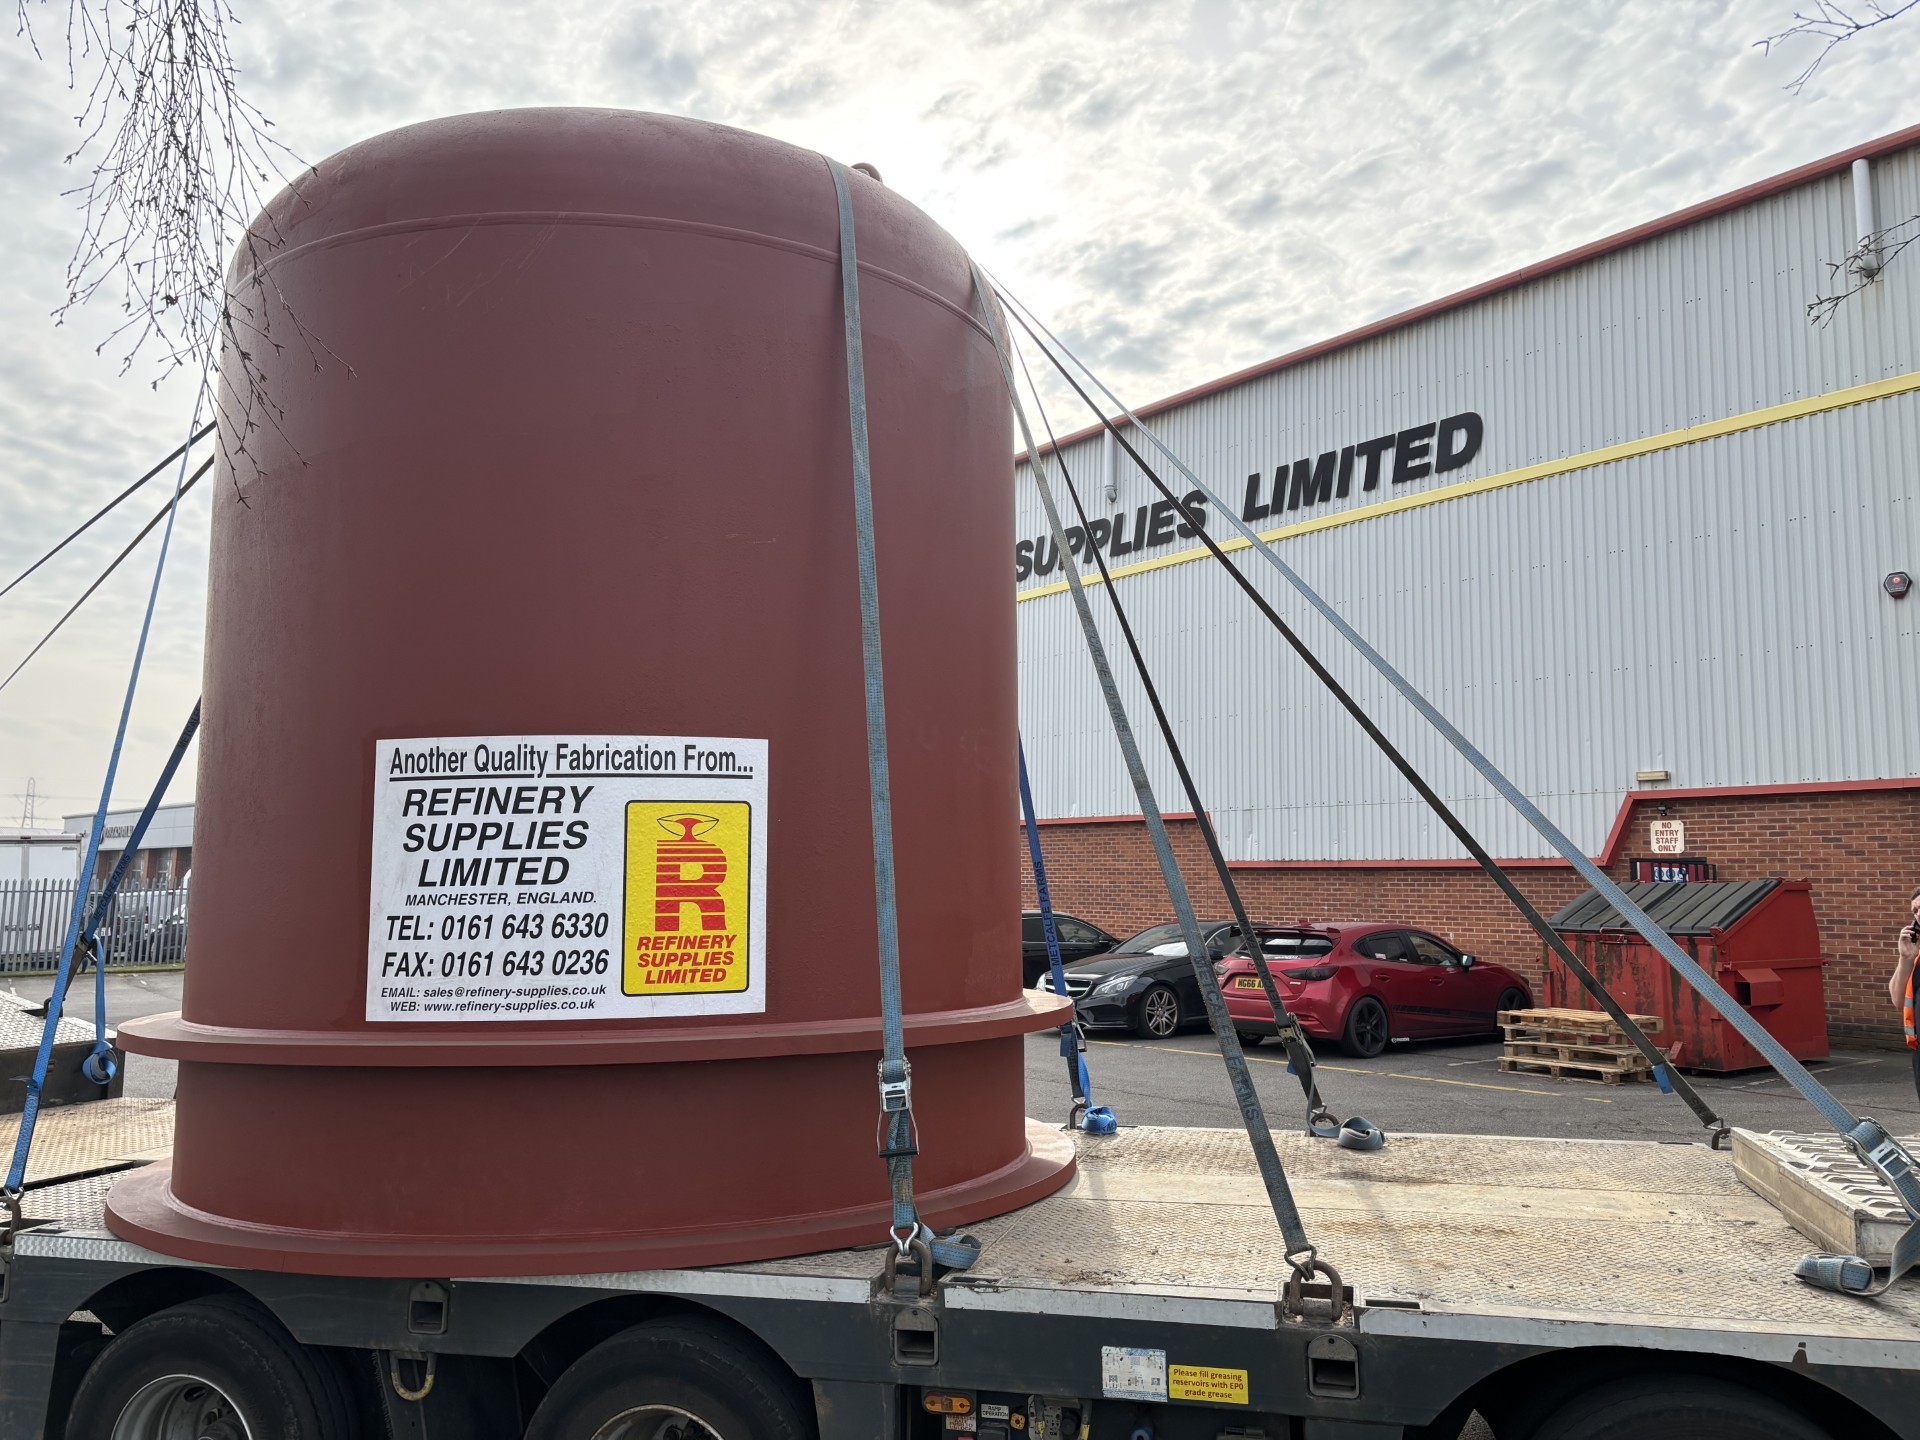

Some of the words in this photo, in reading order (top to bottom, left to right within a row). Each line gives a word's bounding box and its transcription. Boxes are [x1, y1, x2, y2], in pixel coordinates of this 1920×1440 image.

[1016, 489, 1207, 582] SUPPLIES
[1242, 411, 1483, 522] LIMITED
[389, 746, 467, 774] Another
[474, 744, 548, 778] Quality
[555, 743, 676, 772] Fabrication
[684, 744, 753, 772] From...
[402, 785, 595, 817] REFINERY
[403, 820, 589, 852] SUPPLIES
[1655, 837, 1679, 845] STAFF
[113, 854, 130, 881] FARMS
[418, 856, 570, 887] LIMITED
[1033, 861, 1048, 902] FARMS
[405, 892, 511, 907] MANCHESTER,
[517, 891, 597, 905] ENGLAND.
[386, 915, 434, 940] TEL:
[441, 914, 494, 940] 0161
[501, 913, 544, 939] 643
[551, 912, 609, 938] 6330
[1041, 905, 1061, 966] METCALFE
[636, 934, 737, 951] REFINERY
[382, 952, 434, 977] FAX:
[441, 951, 494, 977] 0161
[502, 950, 545, 976] 643
[552, 949, 609, 975] 0236
[637, 951, 735, 968] SUPPLIES
[644, 967, 727, 985] LIMITED
[381, 987, 420, 998] EMAIL:
[423, 985, 607, 1002] sales@refinery-supplies.co.uk
[390, 1001, 420, 1012] WEB:
[424, 999, 596, 1014] www.refinery-supplies.co.uk
[1173, 1369, 1197, 1377] Please
[1199, 1370, 1209, 1378] fill
[1210, 1372, 1242, 1382] greasing
[1173, 1379, 1209, 1388] reservoirs
[1211, 1380, 1228, 1389] with
[1184, 1389, 1206, 1397] grade
[1208, 1390, 1233, 1399] grease
